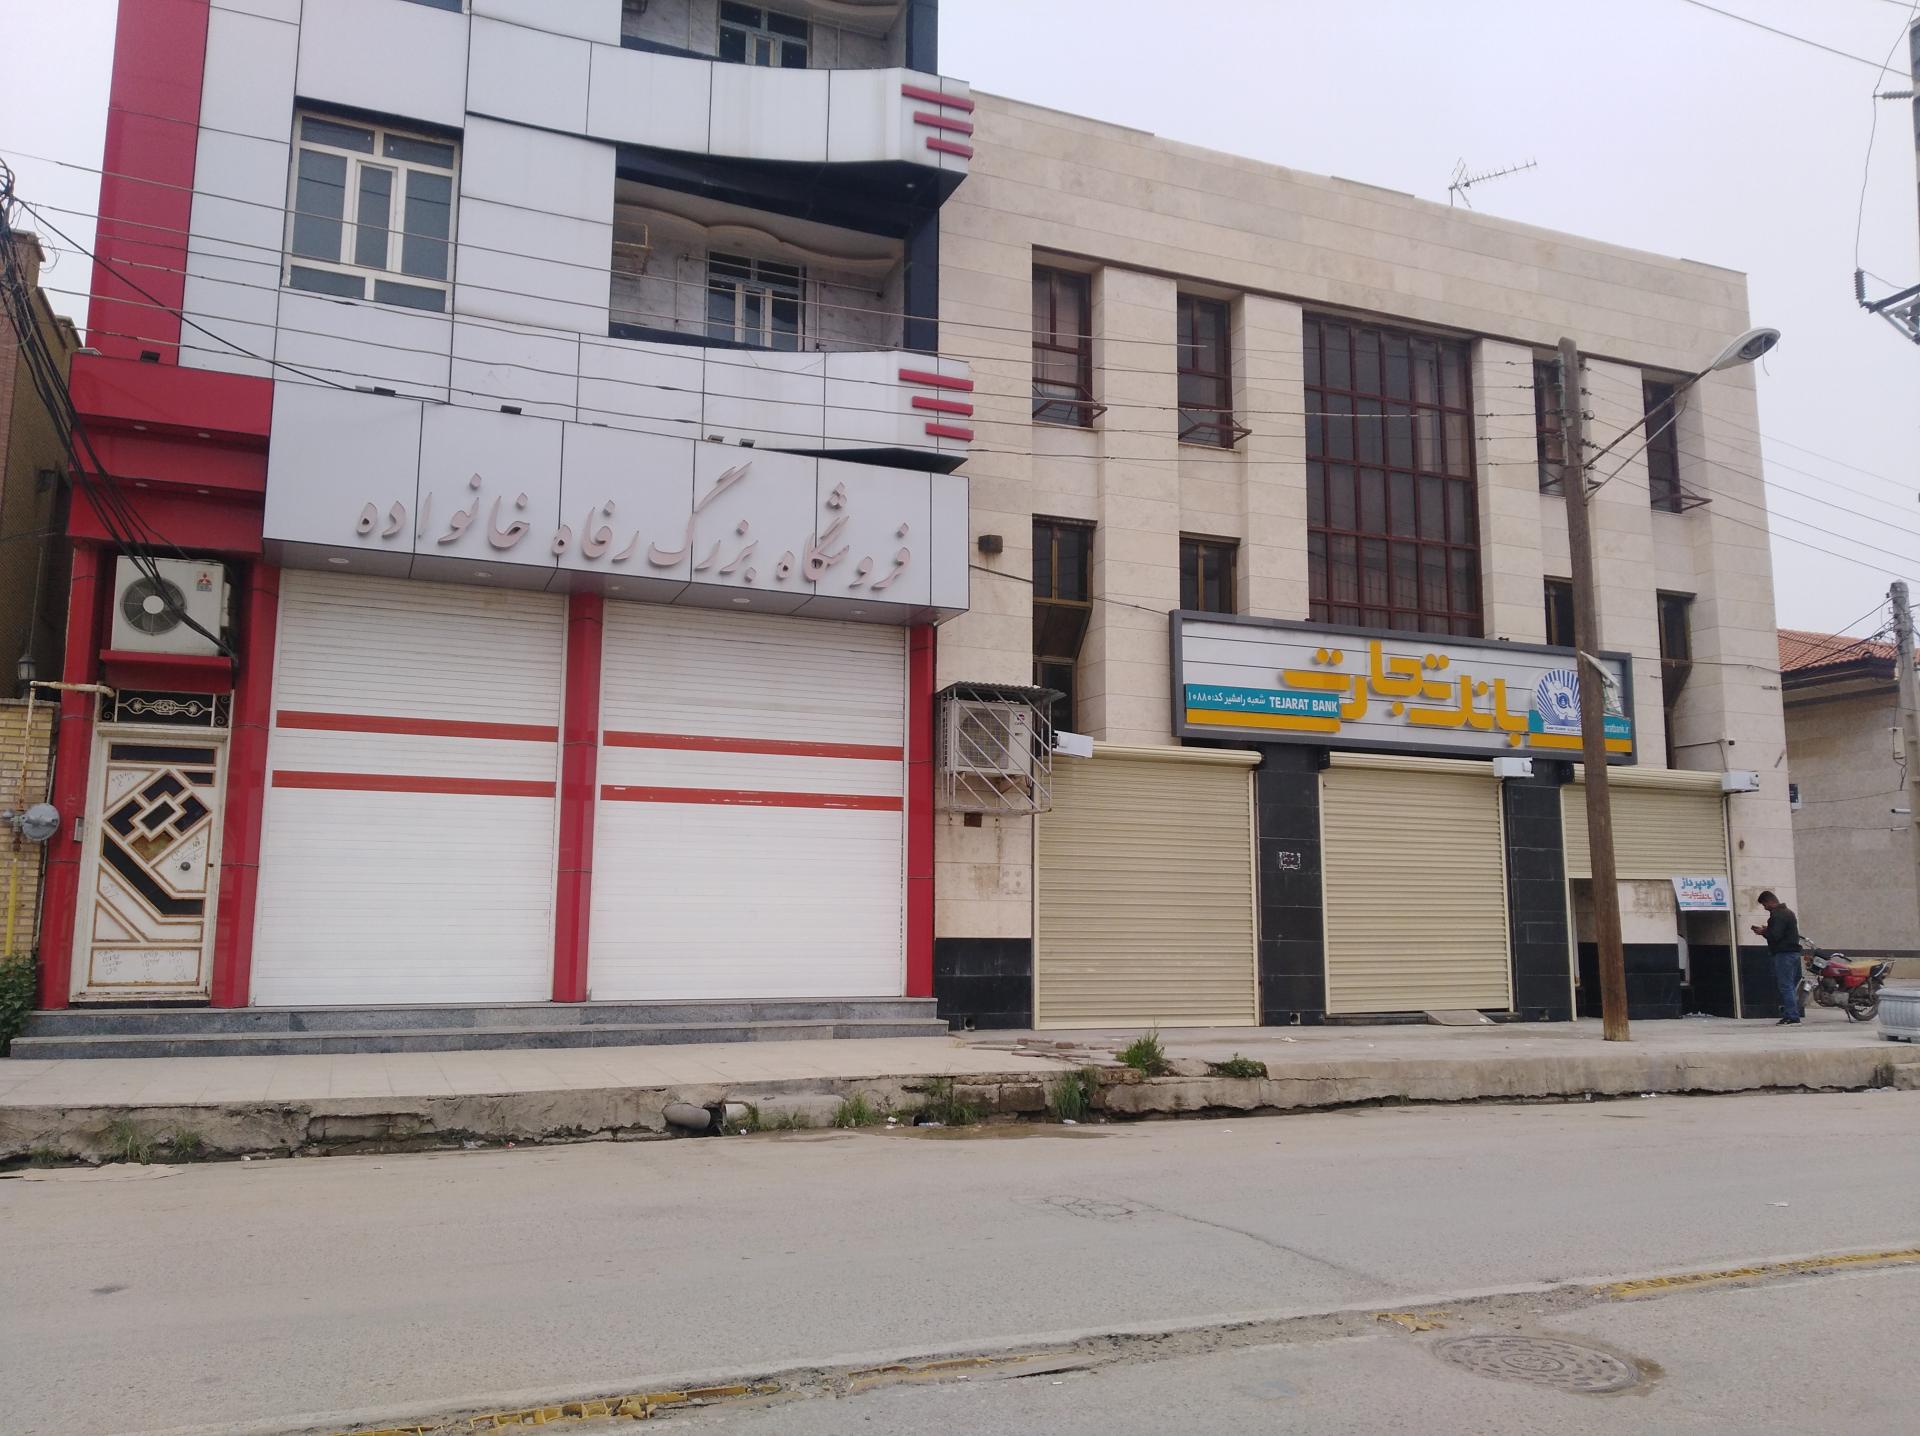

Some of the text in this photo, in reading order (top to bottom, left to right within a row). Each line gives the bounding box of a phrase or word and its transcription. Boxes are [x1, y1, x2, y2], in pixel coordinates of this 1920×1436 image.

[356, 461, 911, 590] فروشگاه بزرگ رفاه خانواده
[1224, 693, 1246, 706] رامشیر
[1247, 694, 1265, 705] شعبه
[1283, 639, 1528, 748] بانک تجارت
[1269, 696, 1338, 713] TEJARAT BANK
